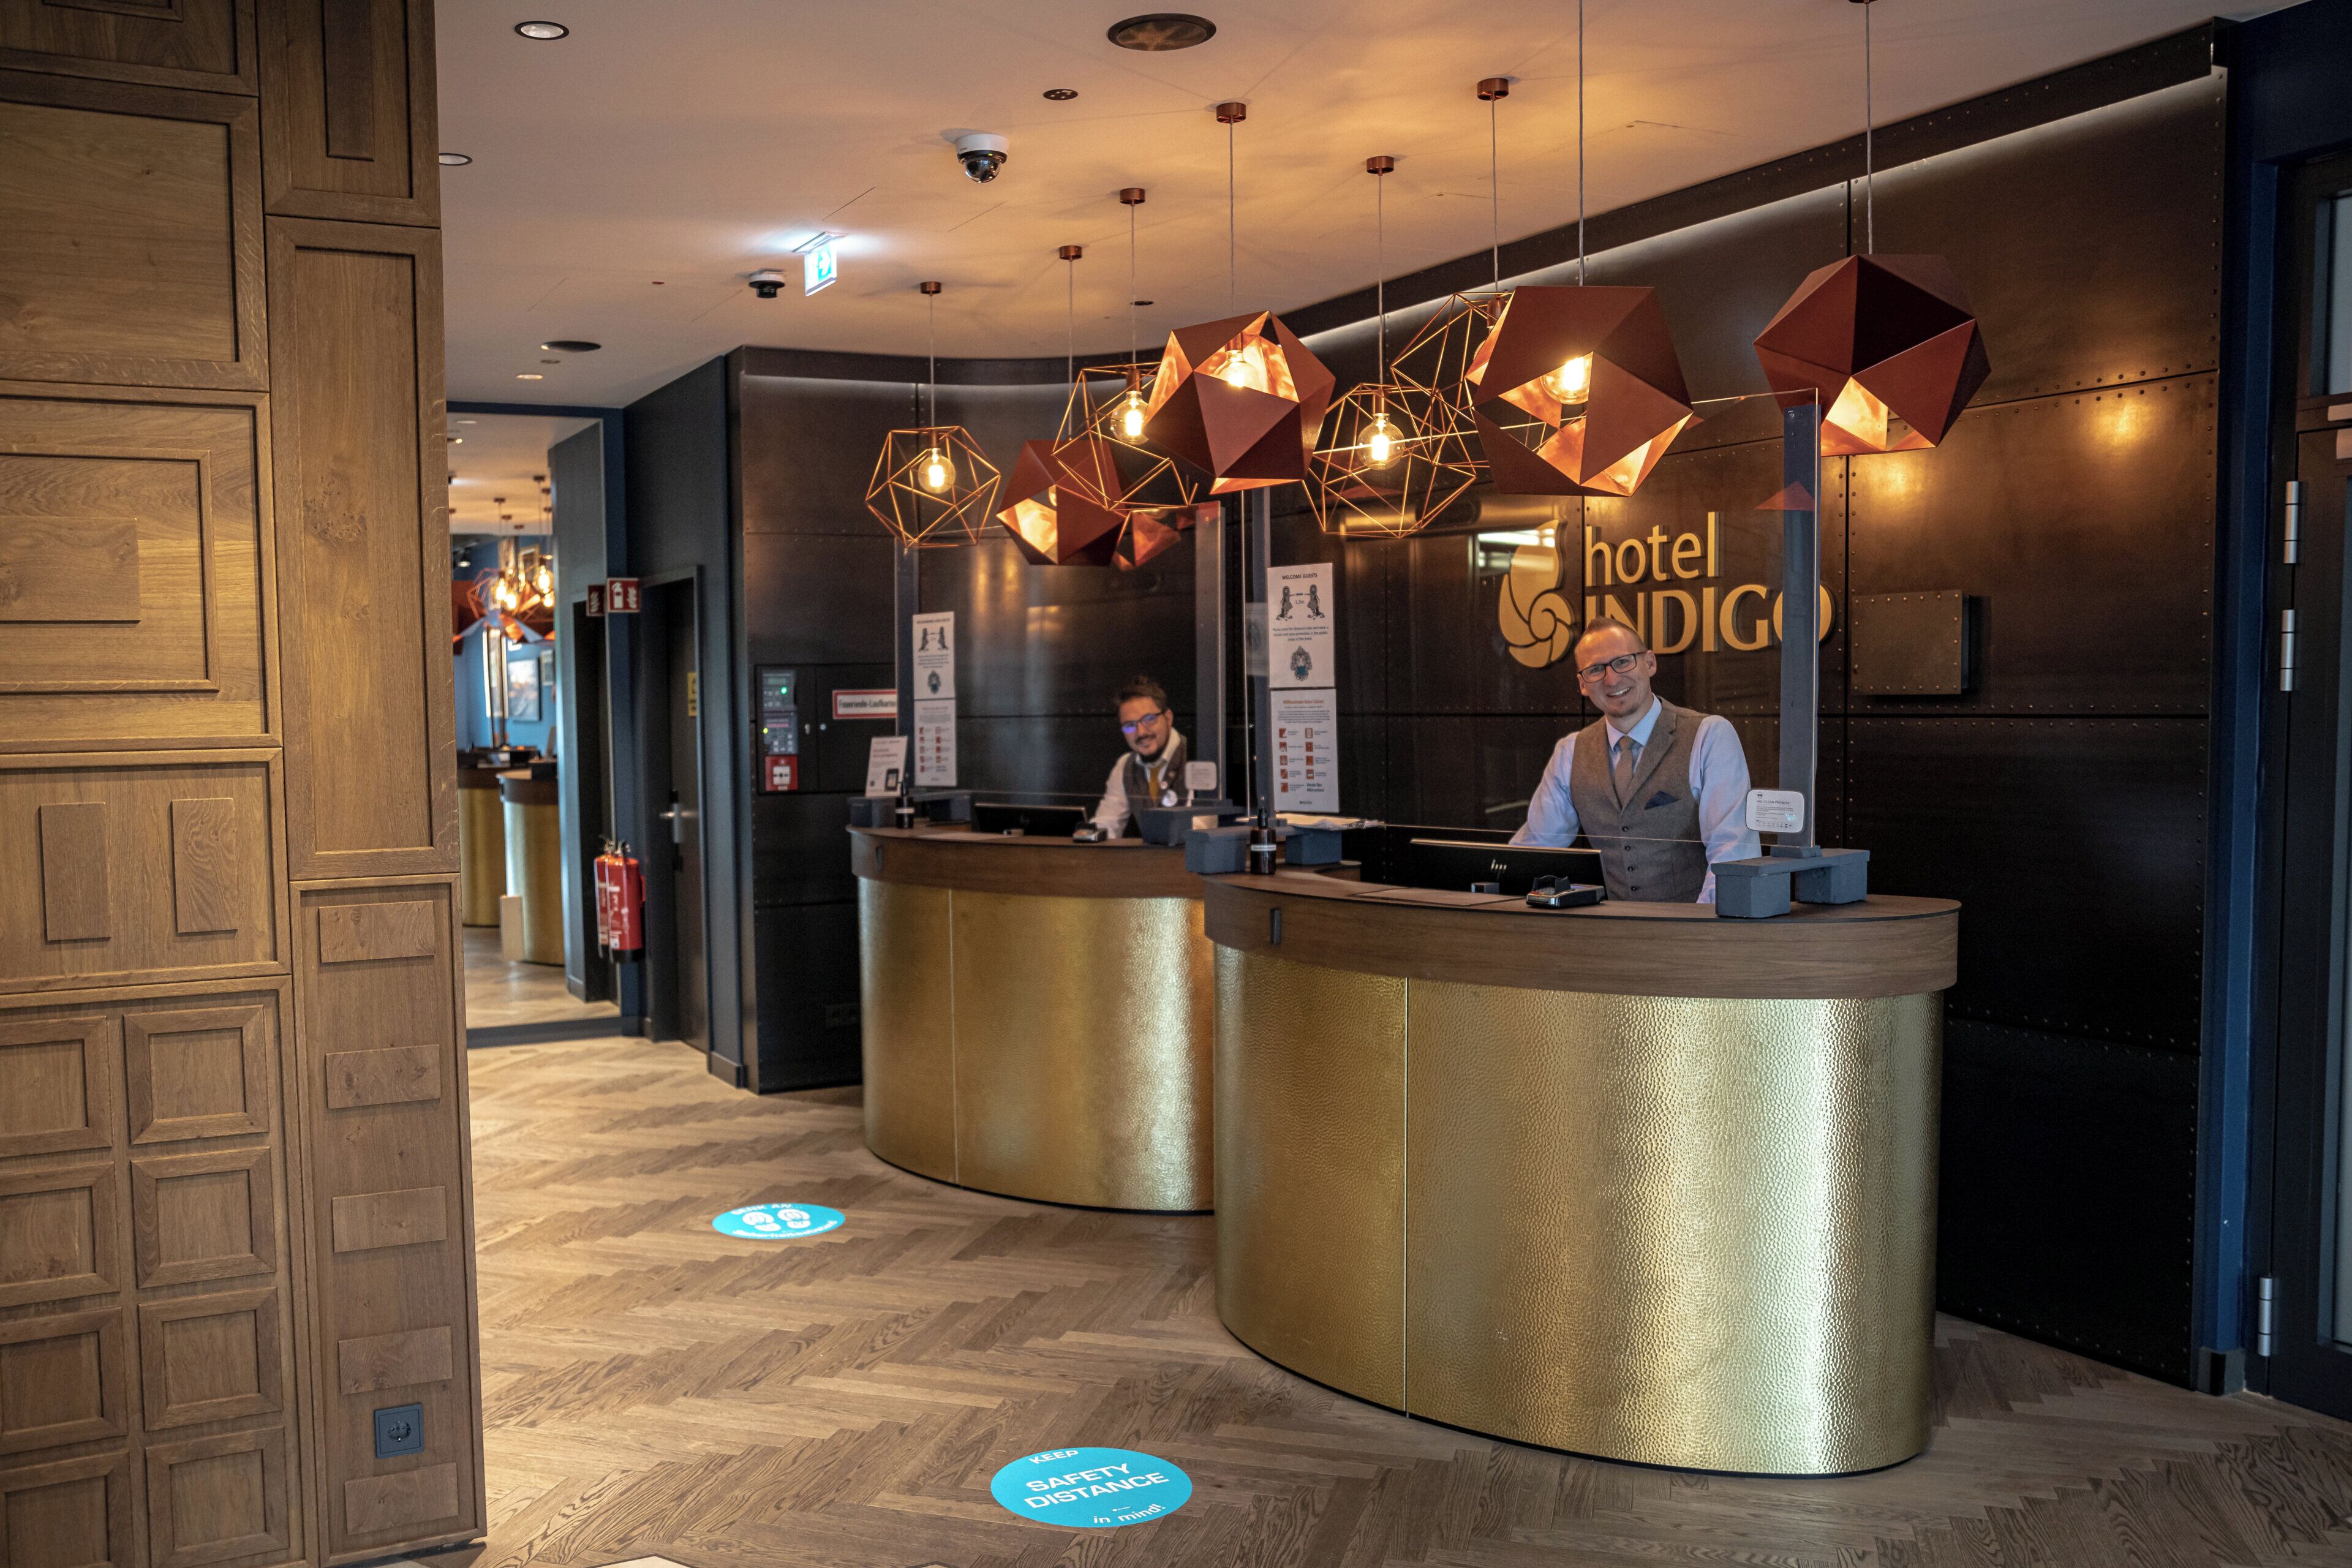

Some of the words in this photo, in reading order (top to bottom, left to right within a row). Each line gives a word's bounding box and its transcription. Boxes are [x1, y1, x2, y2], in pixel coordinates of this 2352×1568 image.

[1585, 511, 1720, 586] hotel
[1028, 1450, 1079, 1464] KEEP
[1023, 1472, 1170, 1509] DISTANCE
[1025, 1463, 1131, 1492] SAFETY
[1093, 1515, 1111, 1524] in
[1117, 1503, 1167, 1522] mind!
